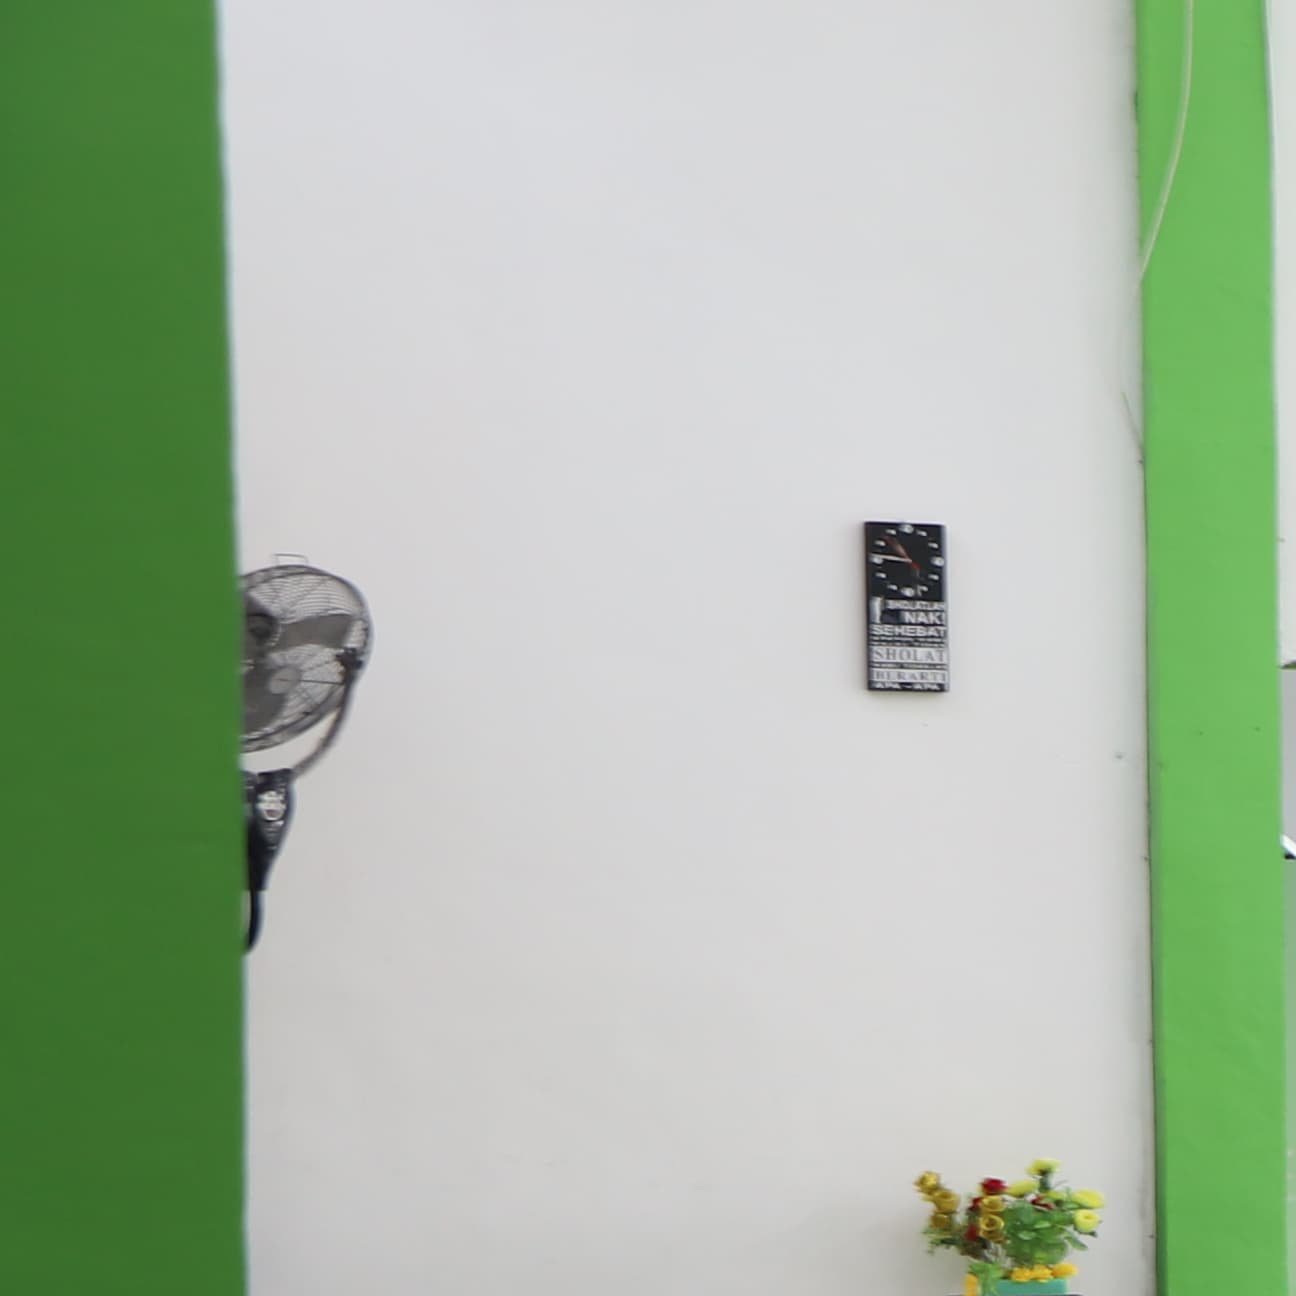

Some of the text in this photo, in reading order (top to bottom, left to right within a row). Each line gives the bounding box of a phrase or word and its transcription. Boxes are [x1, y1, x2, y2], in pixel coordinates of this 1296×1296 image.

[872, 625, 946, 637] SEHEBAT
[873, 648, 946, 662] SHOLAT
[874, 671, 947, 681] BERARTI
